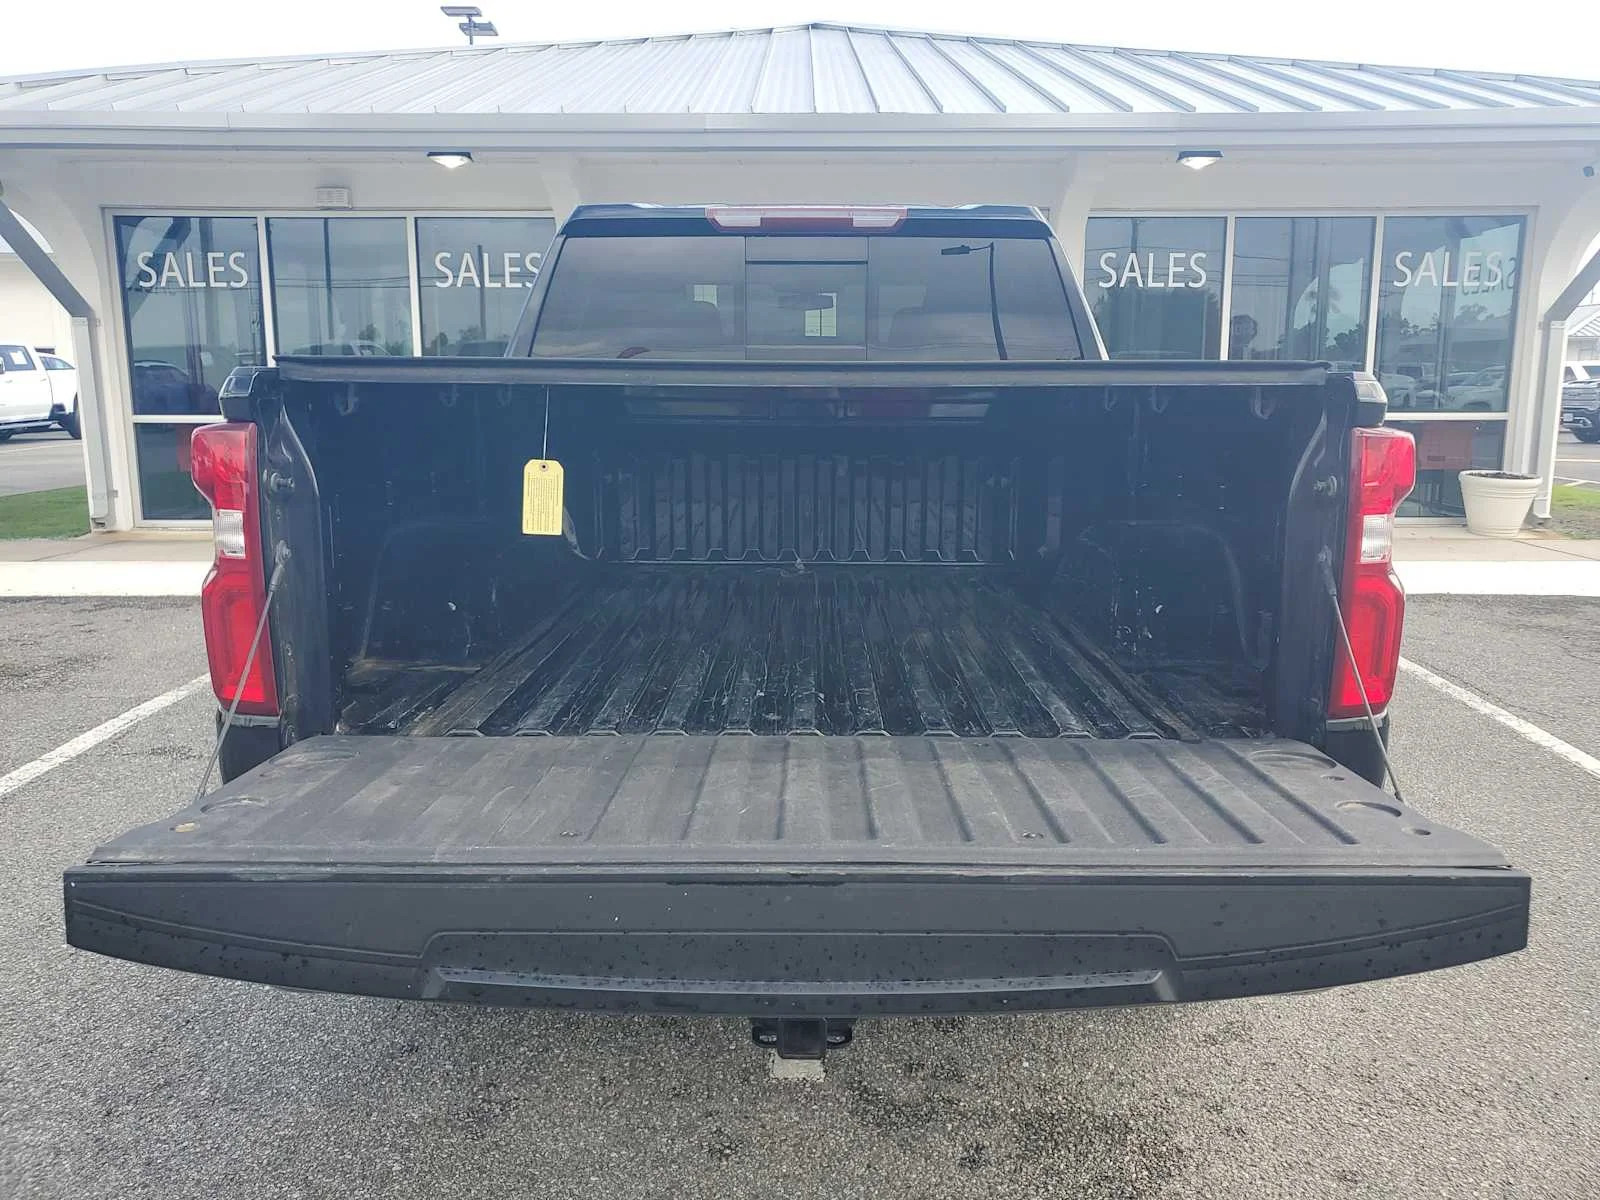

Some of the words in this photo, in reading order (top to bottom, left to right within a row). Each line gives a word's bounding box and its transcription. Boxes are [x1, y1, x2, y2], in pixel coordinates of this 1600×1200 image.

[137, 251, 248, 288] SALES
[435, 252, 541, 288] SALES
[1098, 252, 1207, 288] SALES
[1393, 251, 1502, 287] SALES
